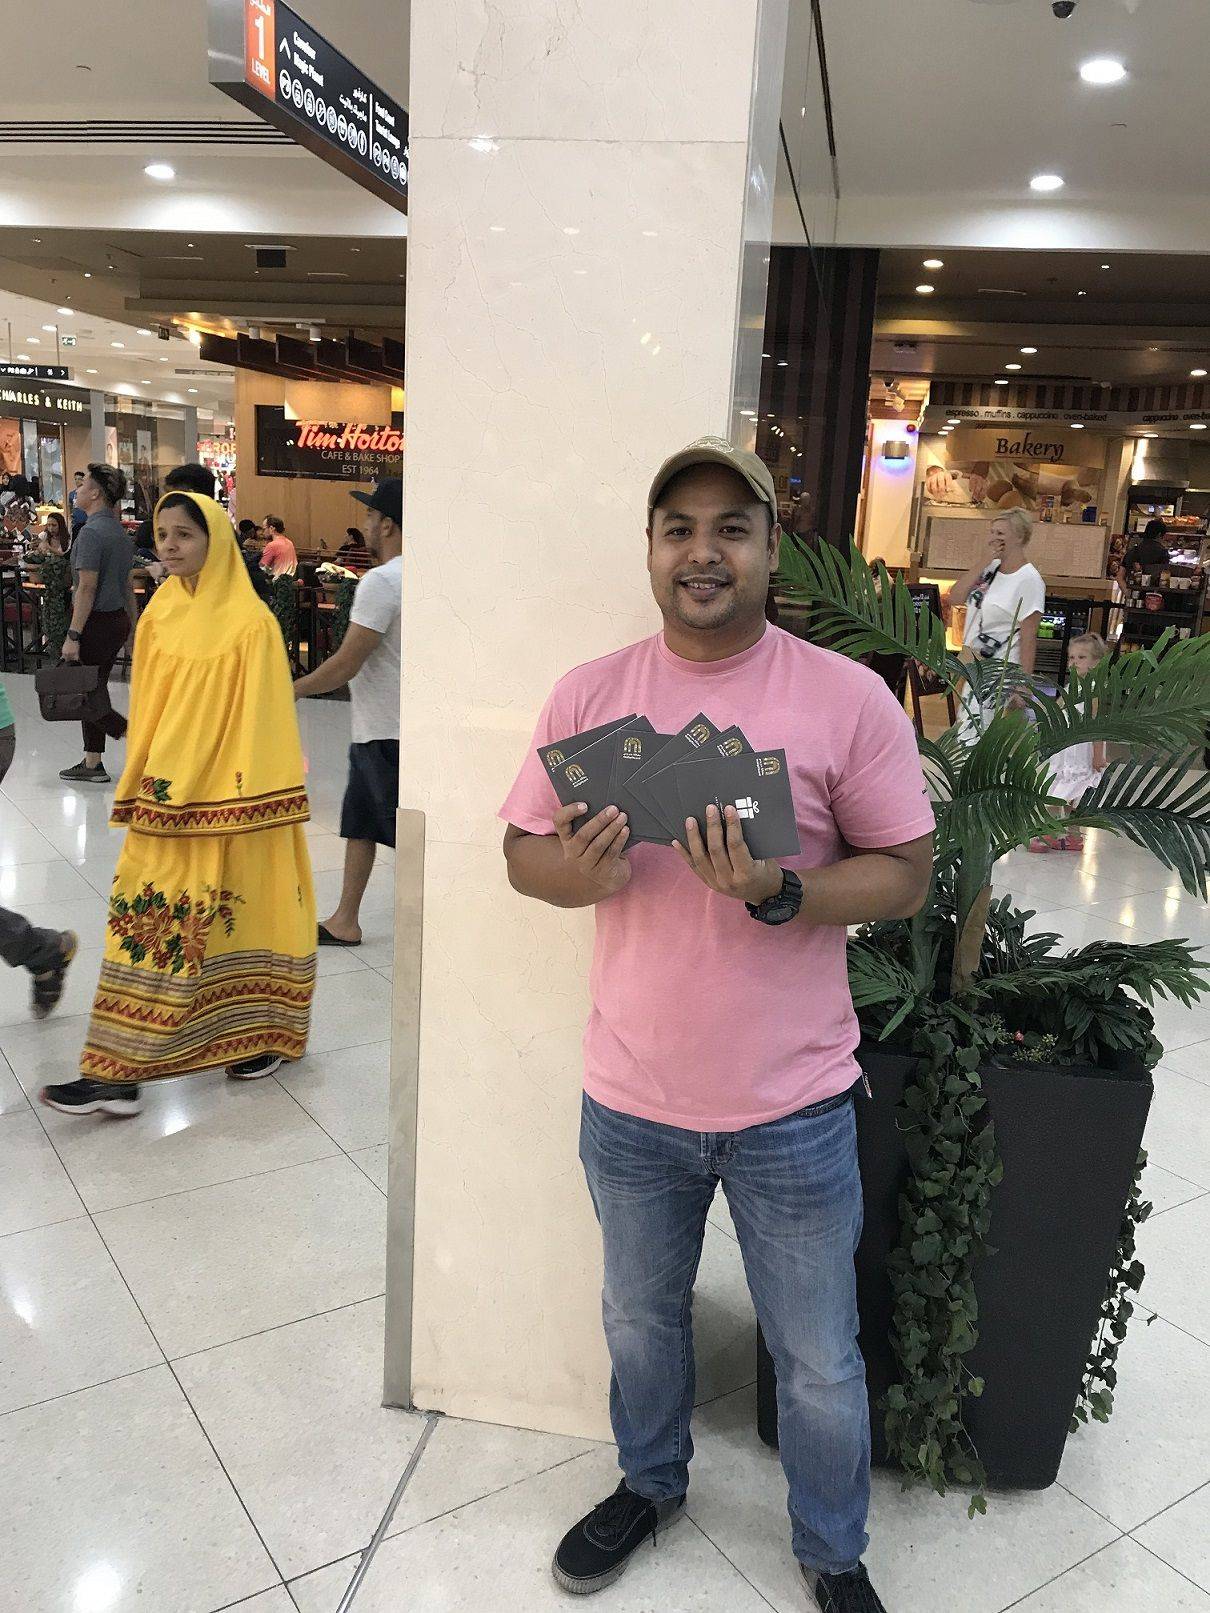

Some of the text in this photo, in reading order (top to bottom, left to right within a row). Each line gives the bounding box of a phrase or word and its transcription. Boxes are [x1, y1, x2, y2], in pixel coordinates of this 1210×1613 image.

[254, 16, 264, 60] 1
[44, 396, 52, 408] &
[57, 398, 83, 412] KEITH
[945, 409, 980, 418] espresso
[984, 409, 1011, 419] muffins
[295, 420, 338, 449] Tim
[994, 432, 1064, 462] Bakery
[321, 450, 401, 463] CAFE & BAKE SHOP
[341, 464, 380, 475] EST 1964
